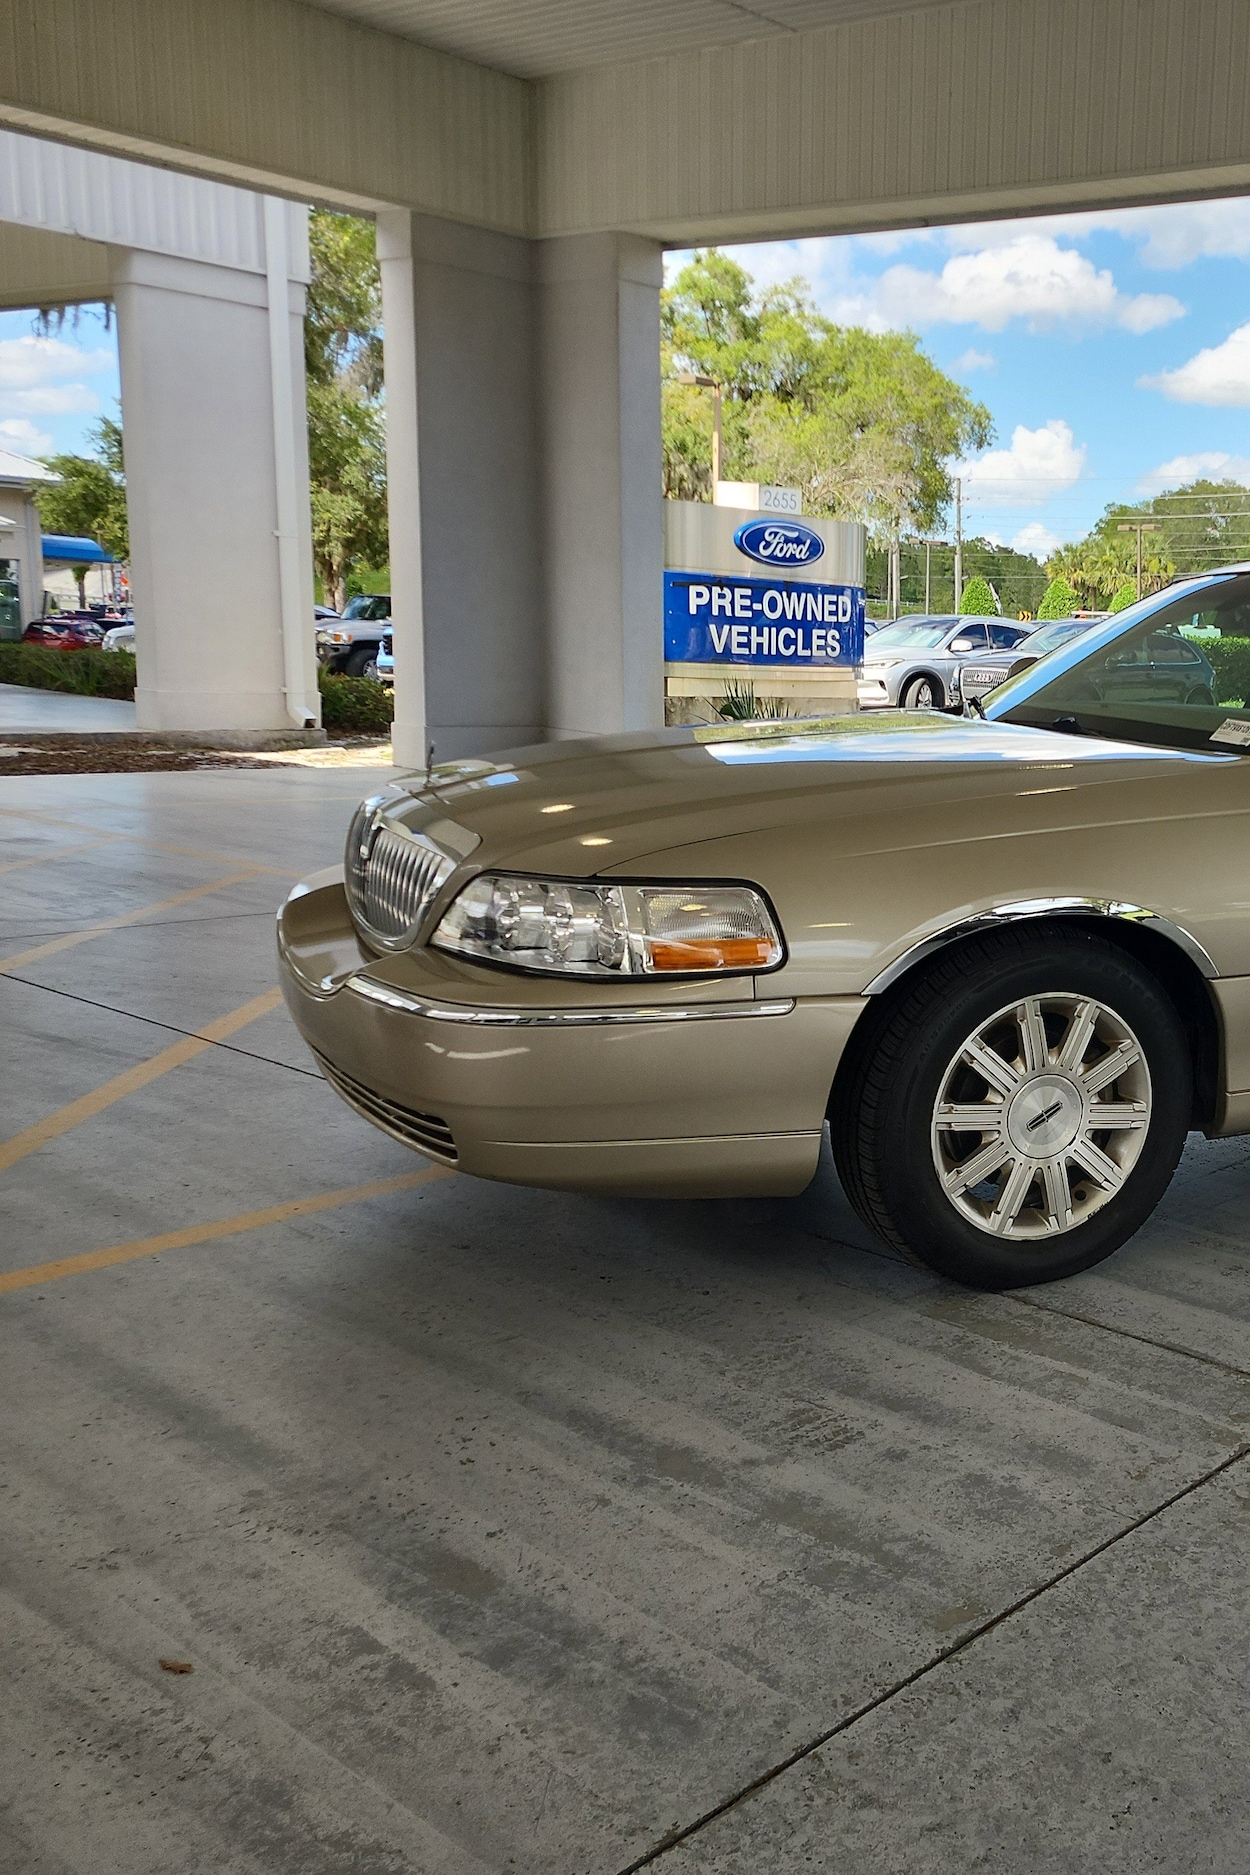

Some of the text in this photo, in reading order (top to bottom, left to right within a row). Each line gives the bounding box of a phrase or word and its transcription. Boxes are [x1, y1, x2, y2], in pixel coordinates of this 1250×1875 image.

[764, 490, 797, 510] 2655
[759, 527, 811, 559] Ford
[689, 585, 851, 622] PRE-OWNED
[709, 624, 841, 657] VEHICLES
